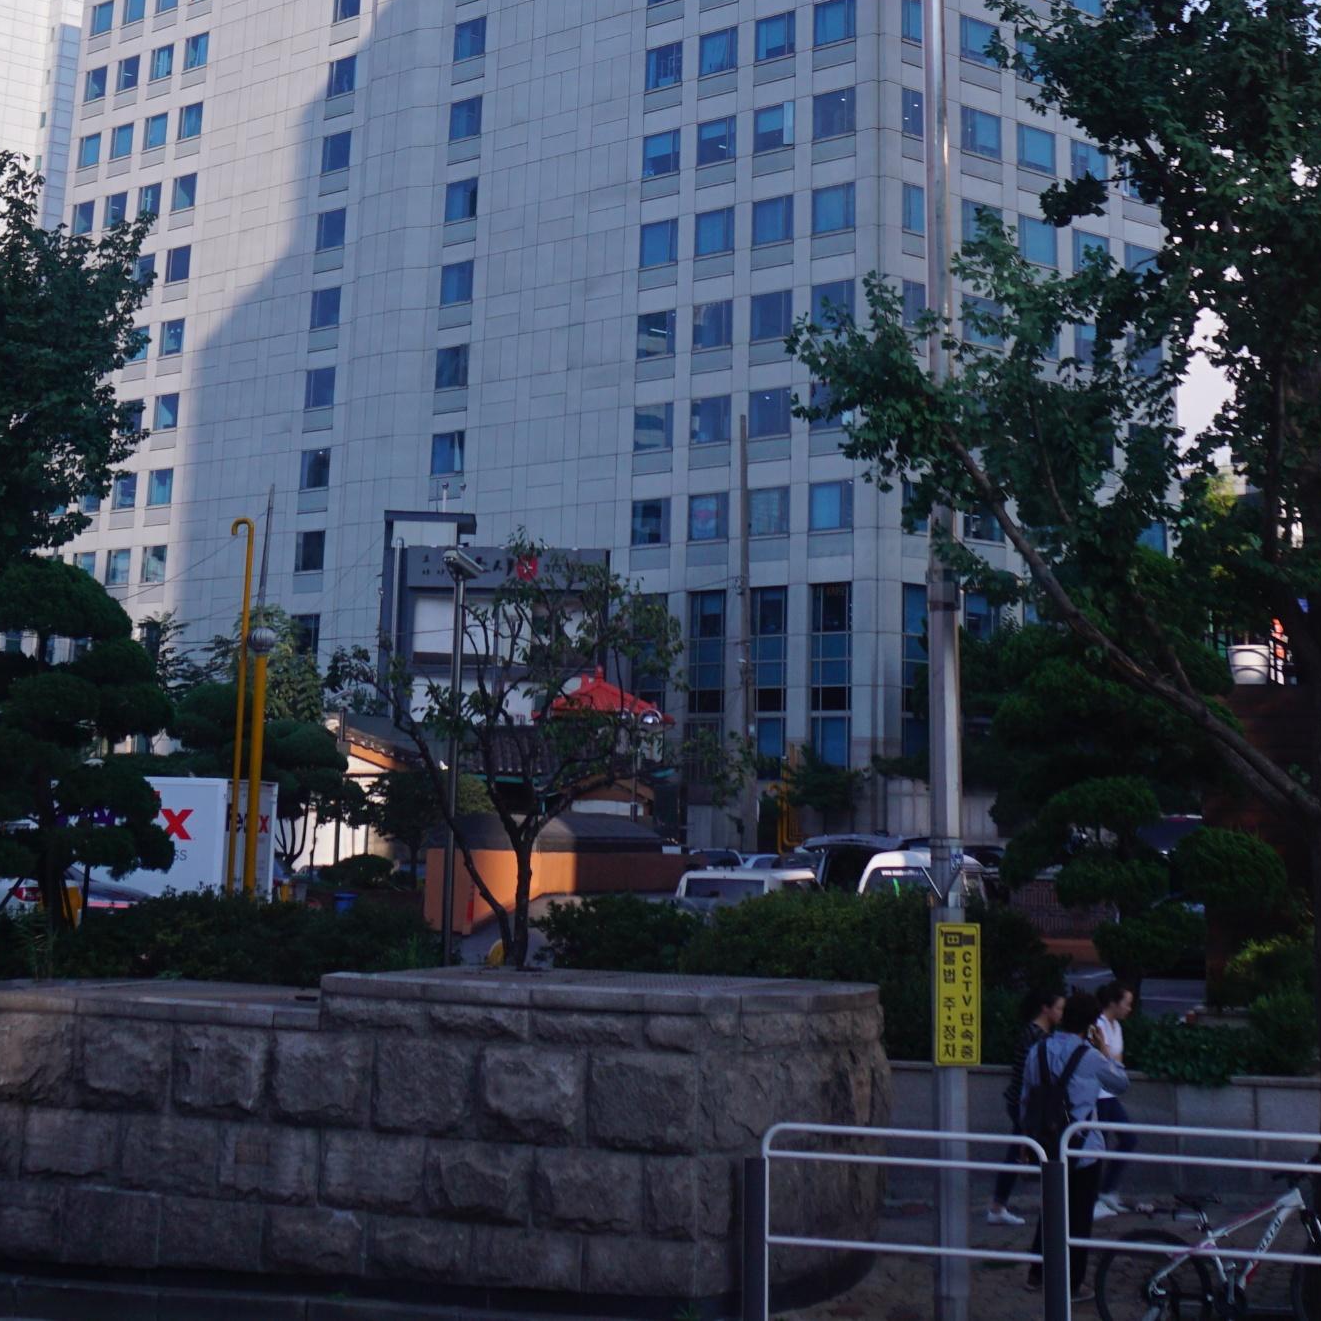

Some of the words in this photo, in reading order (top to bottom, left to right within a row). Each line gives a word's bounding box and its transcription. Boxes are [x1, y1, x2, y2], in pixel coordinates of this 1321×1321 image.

[943, 951, 956, 984] 불법
[962, 951, 973, 1007] CCTV
[961, 1013, 974, 1060] 단속중
